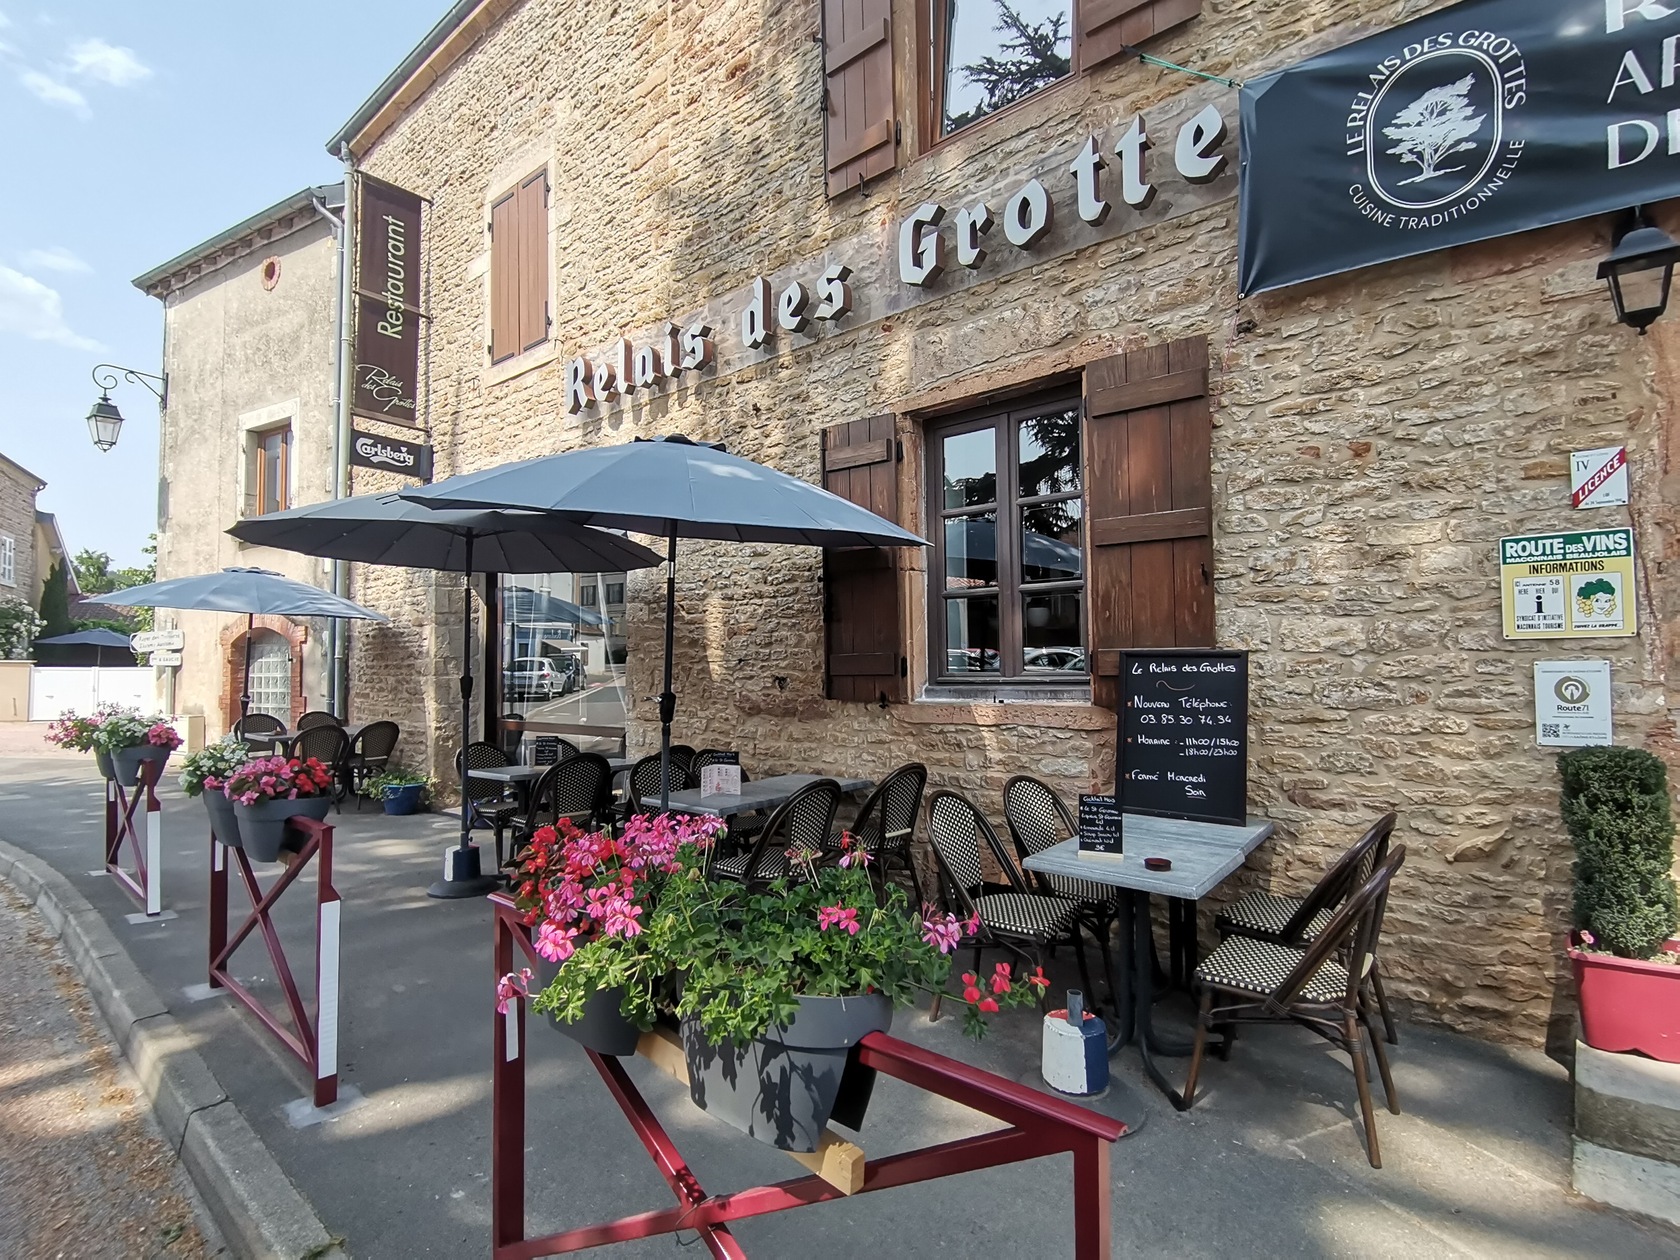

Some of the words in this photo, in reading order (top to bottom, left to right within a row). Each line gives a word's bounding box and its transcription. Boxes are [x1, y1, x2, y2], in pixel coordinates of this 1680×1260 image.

[1402, 31, 1453, 61] DES
[1458, 29, 1527, 110] GROTTES
[1348, 183, 1396, 228] CUISINE
[1399, 138, 1526, 230] TRADITIONNELLE
[377, 214, 406, 340] Restaurant
[564, 320, 714, 417] Relais
[741, 264, 853, 350] des
[356, 363, 404, 388] Relais
[361, 379, 377, 390] des
[373, 385, 416, 412] Grottes
[355, 437, 415, 466] Carlsberg
[1576, 460, 1589, 471] IV
[1579, 454, 1620, 501] LICENCE
[1505, 538, 1564, 557] ROUTE
[1566, 544, 1584, 553] DES
[1582, 533, 1627, 551] VINS
[1566, 550, 1627, 559] BEAUJOLAIS
[1529, 560, 1604, 574] INFORMATIONS
[1132, 663, 1143, 675] Le
[1149, 662, 1177, 673] Relais
[1182, 663, 1198, 672] des
[1200, 662, 1236, 673] Grottes
[1134, 695, 1170, 709] Nouveau
[1557, 704, 1589, 712] Route71
[1137, 734, 1170, 745] Horaire
[1131, 769, 1160, 781] Fermé
[1167, 771, 1207, 783] Mercredi
[1184, 784, 1207, 797] Soir
